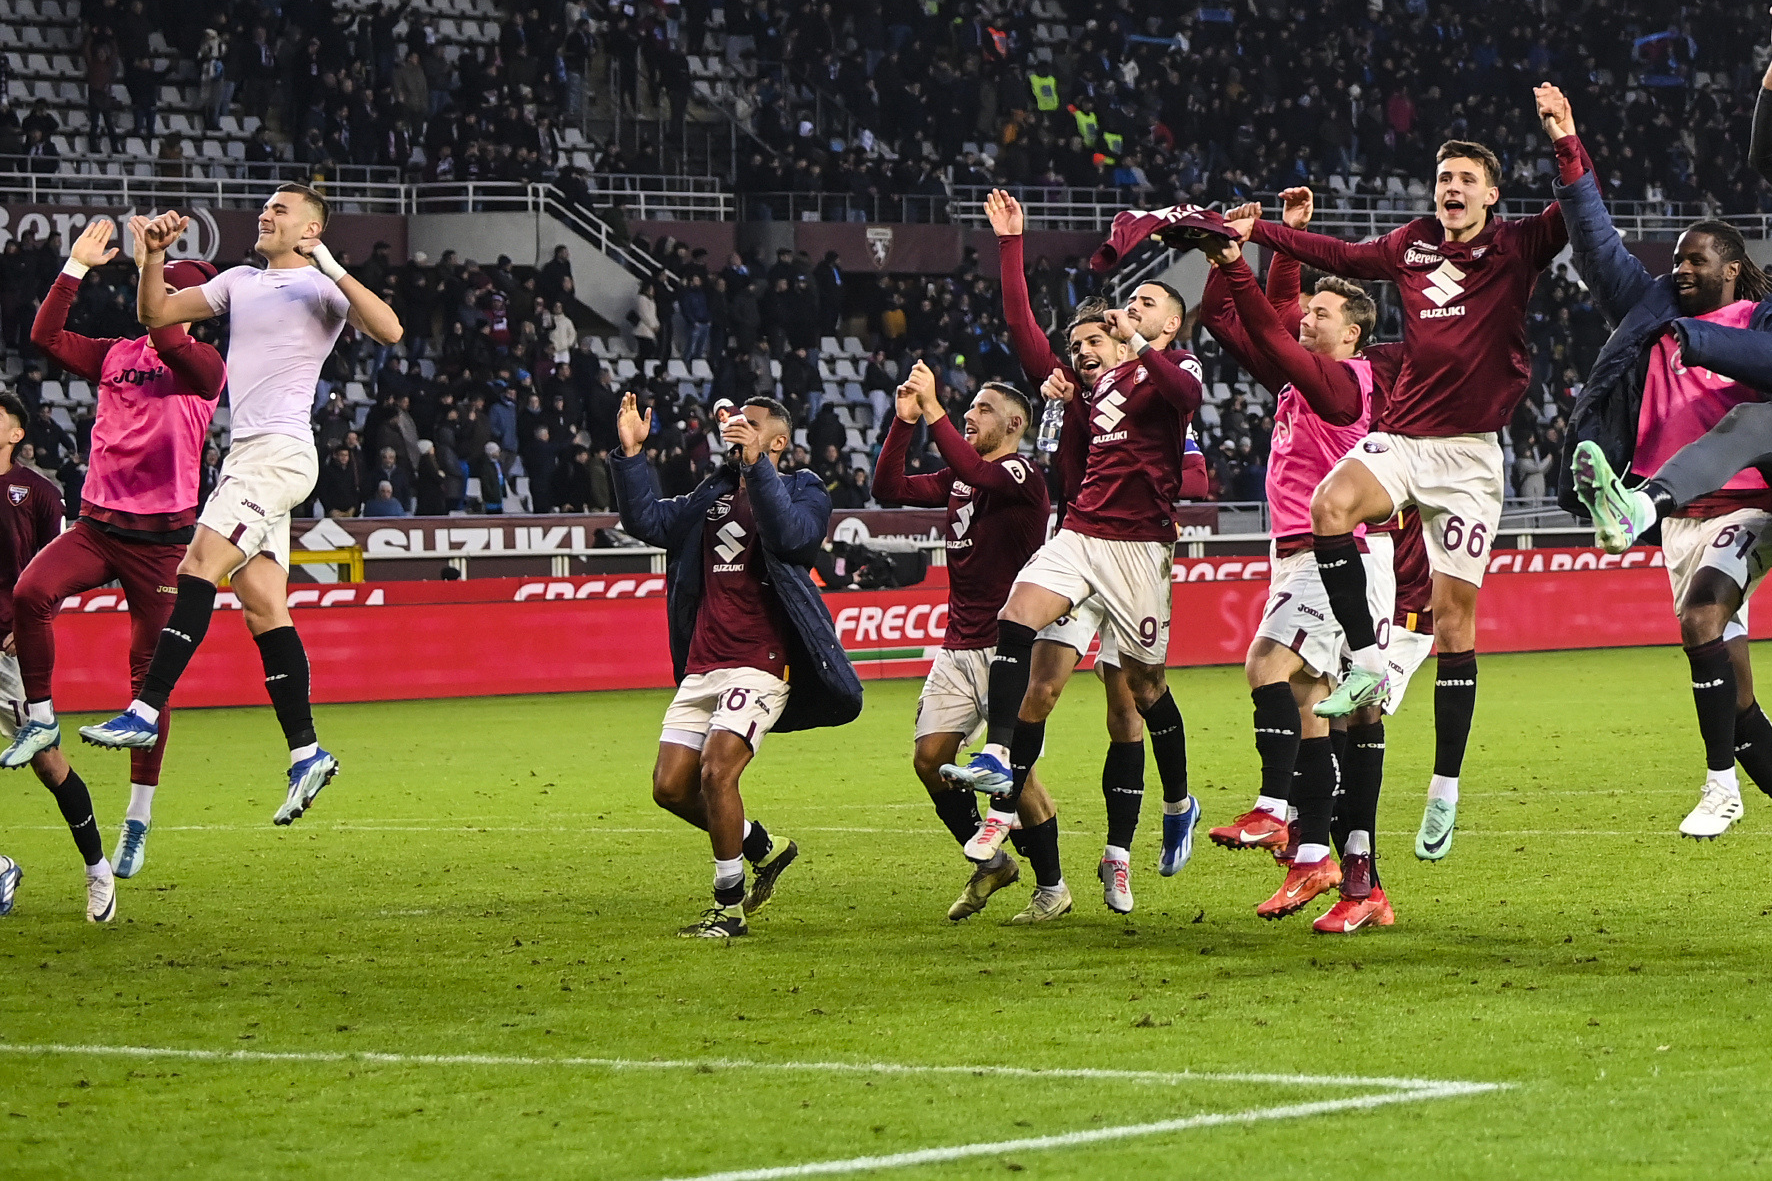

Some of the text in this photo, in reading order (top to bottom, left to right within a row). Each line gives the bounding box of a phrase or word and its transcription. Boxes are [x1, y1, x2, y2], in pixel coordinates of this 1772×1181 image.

[1420, 305, 1465, 318] SUZUKI
[1092, 431, 1128, 444] SUZUKI
[240, 498, 266, 517] Joma
[366, 523, 588, 555] SUZUKI
[1443, 515, 1487, 558] 66
[1712, 524, 1757, 560] 61
[713, 564, 744, 573] SUZUKI
[1297, 603, 1325, 622] Joma
[1139, 616, 1158, 648] 9
